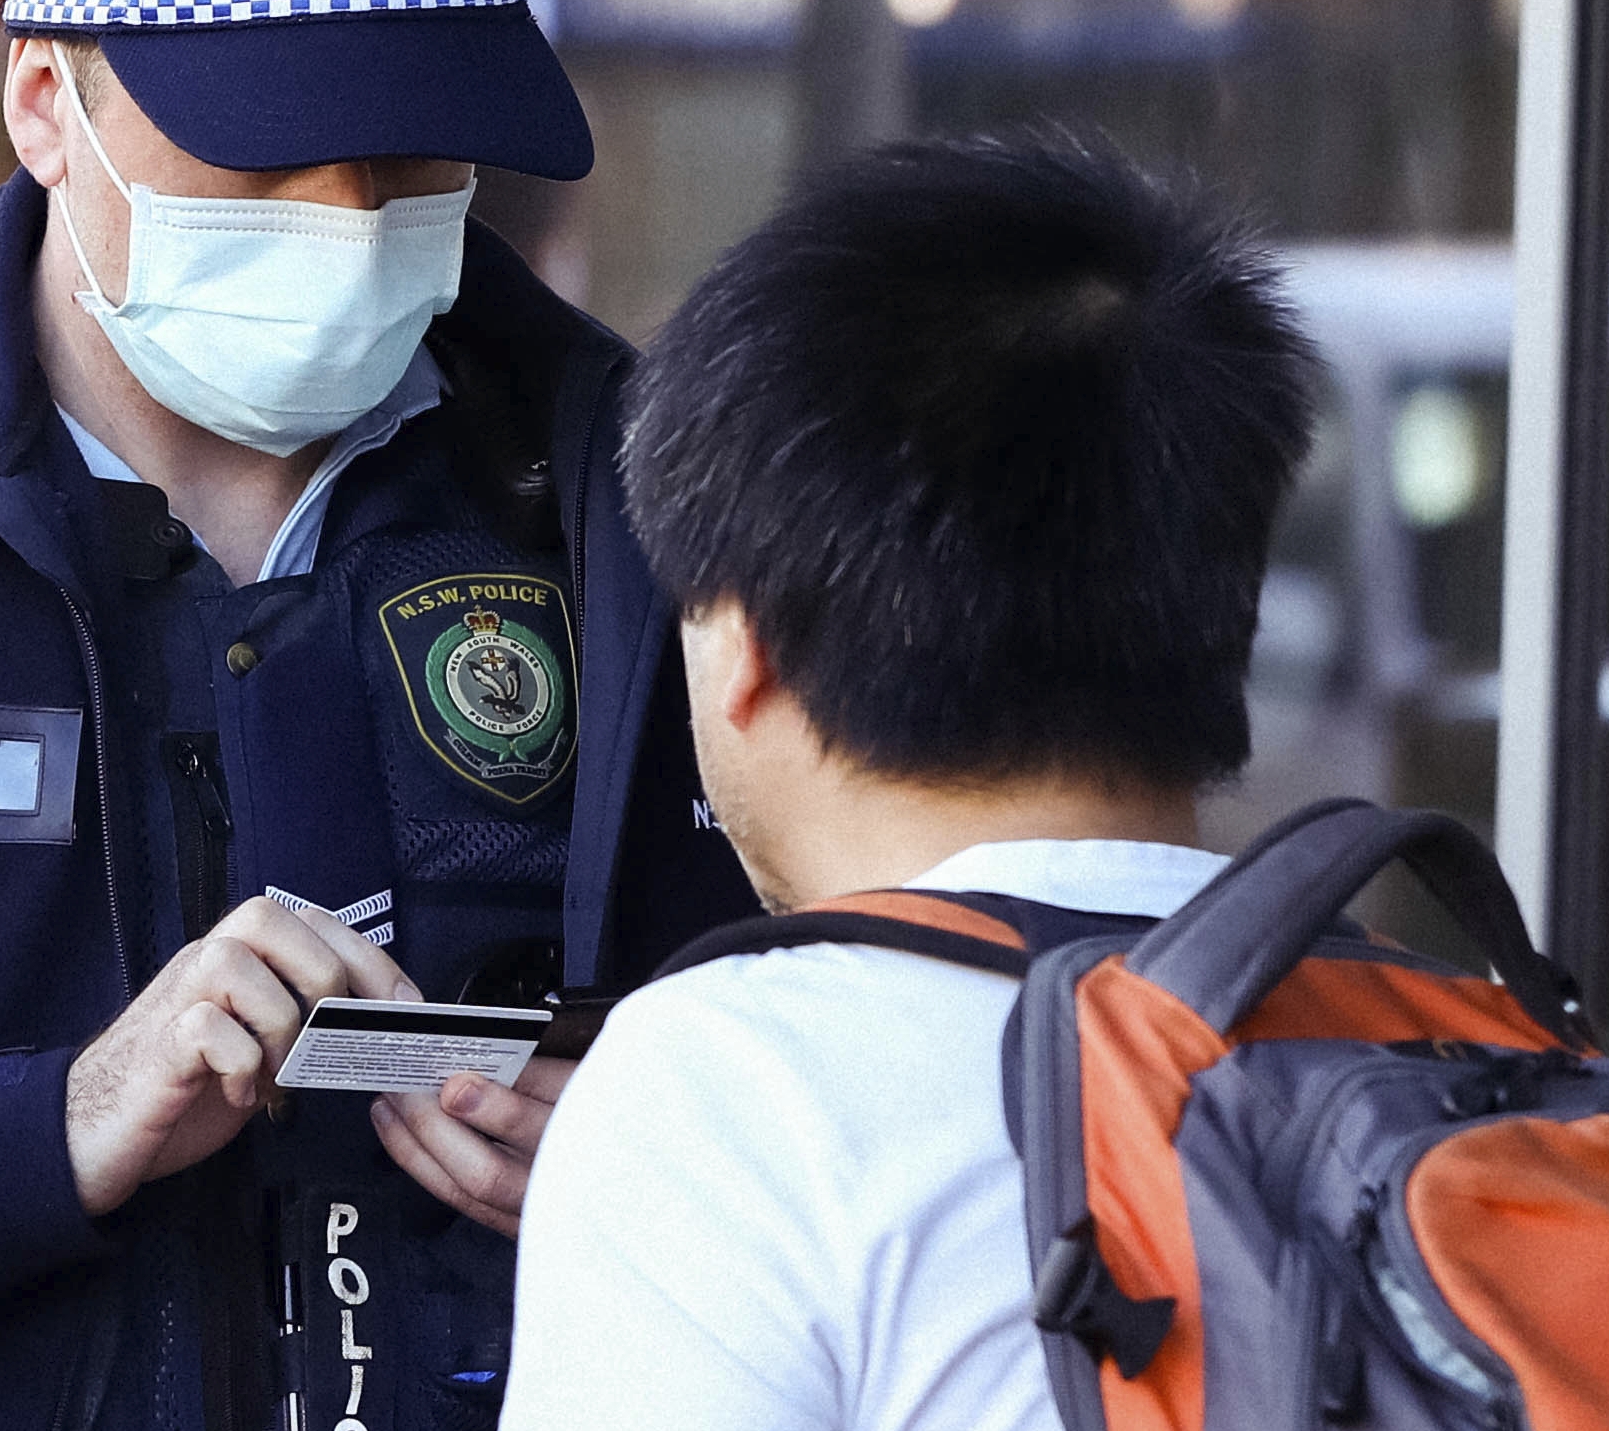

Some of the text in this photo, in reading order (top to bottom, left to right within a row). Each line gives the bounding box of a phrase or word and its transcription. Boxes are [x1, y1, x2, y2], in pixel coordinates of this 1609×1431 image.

[469, 585, 548, 606] POLICE
[450, 636, 539, 672] NEW SOUTH WALES
[468, 709, 542, 731] POLICE FORCE
